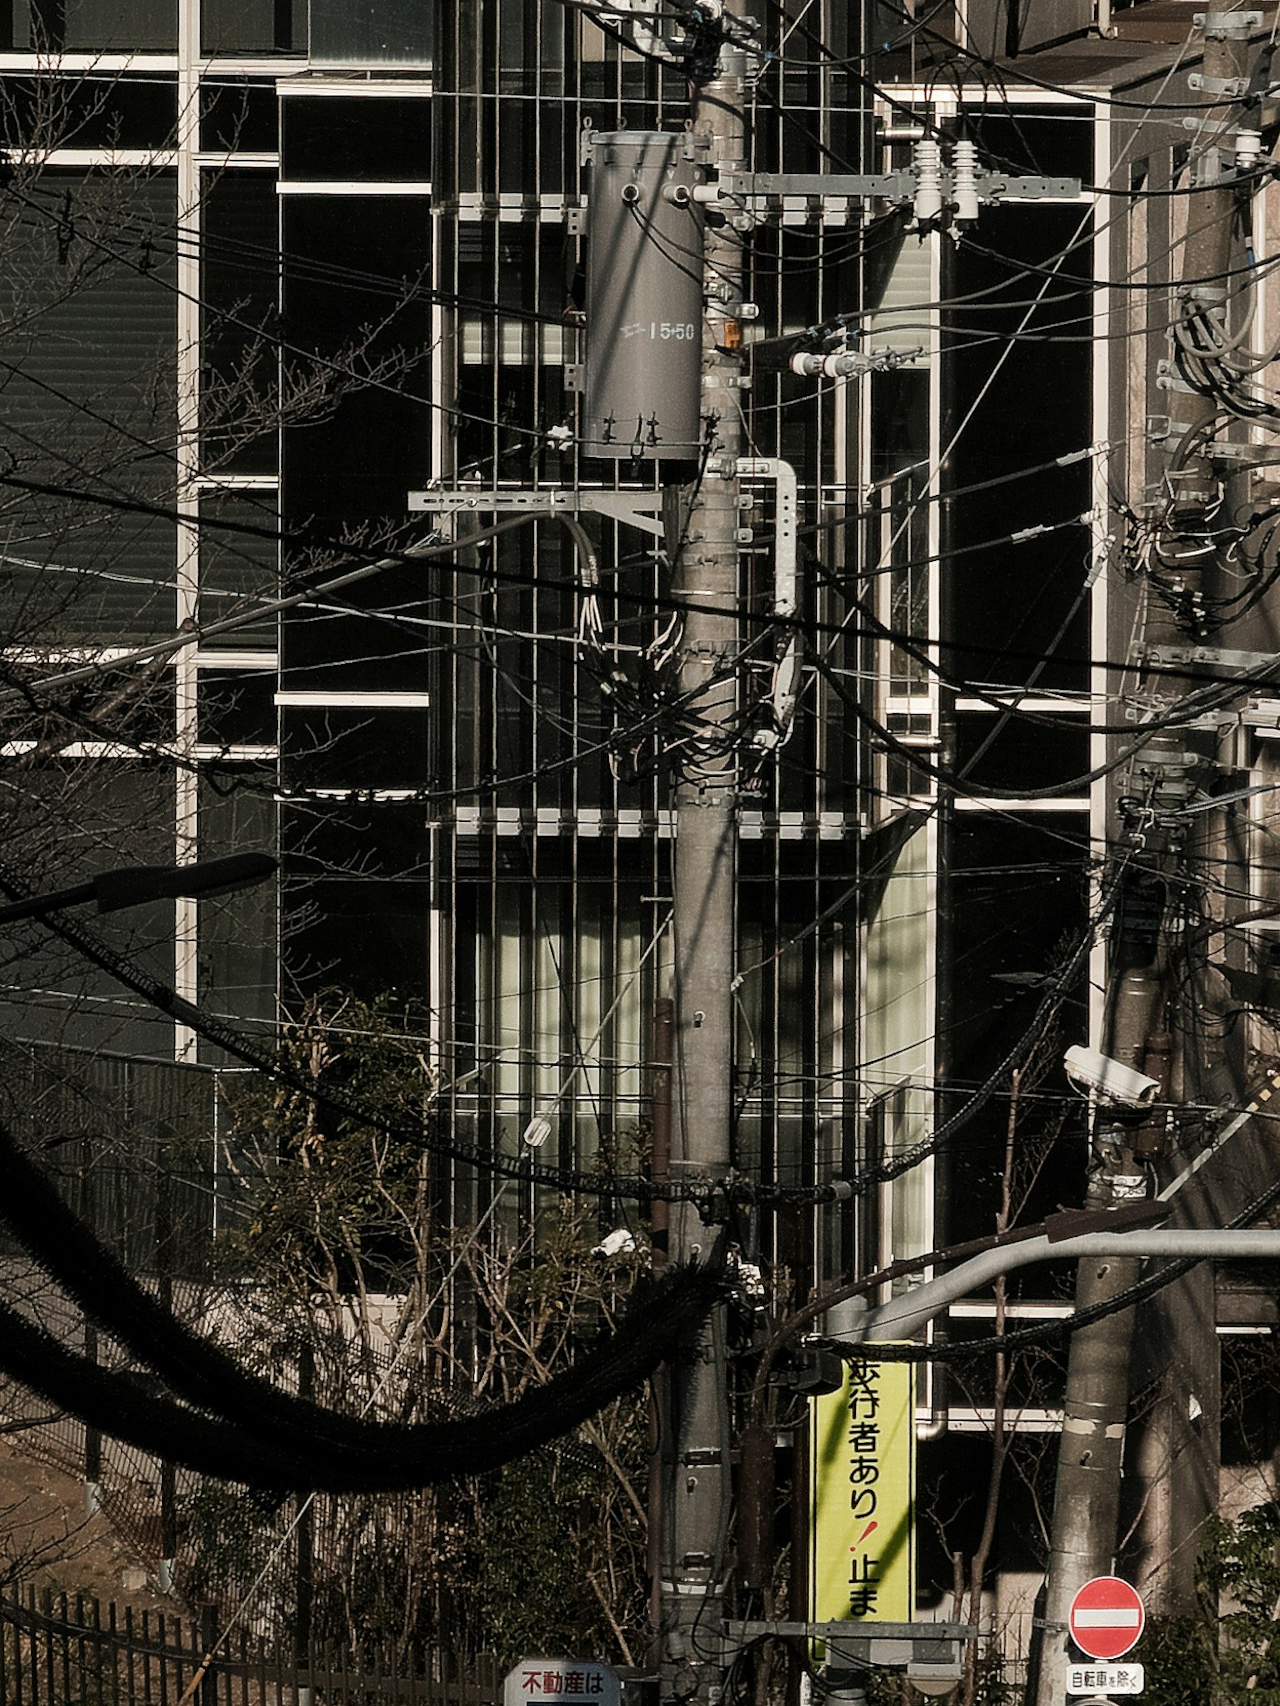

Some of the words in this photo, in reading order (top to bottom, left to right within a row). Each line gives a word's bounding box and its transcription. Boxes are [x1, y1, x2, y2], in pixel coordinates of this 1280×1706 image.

[522, 1670, 604, 1695] 不動産は
[1072, 1670, 1138, 1689] 自転車を除く
